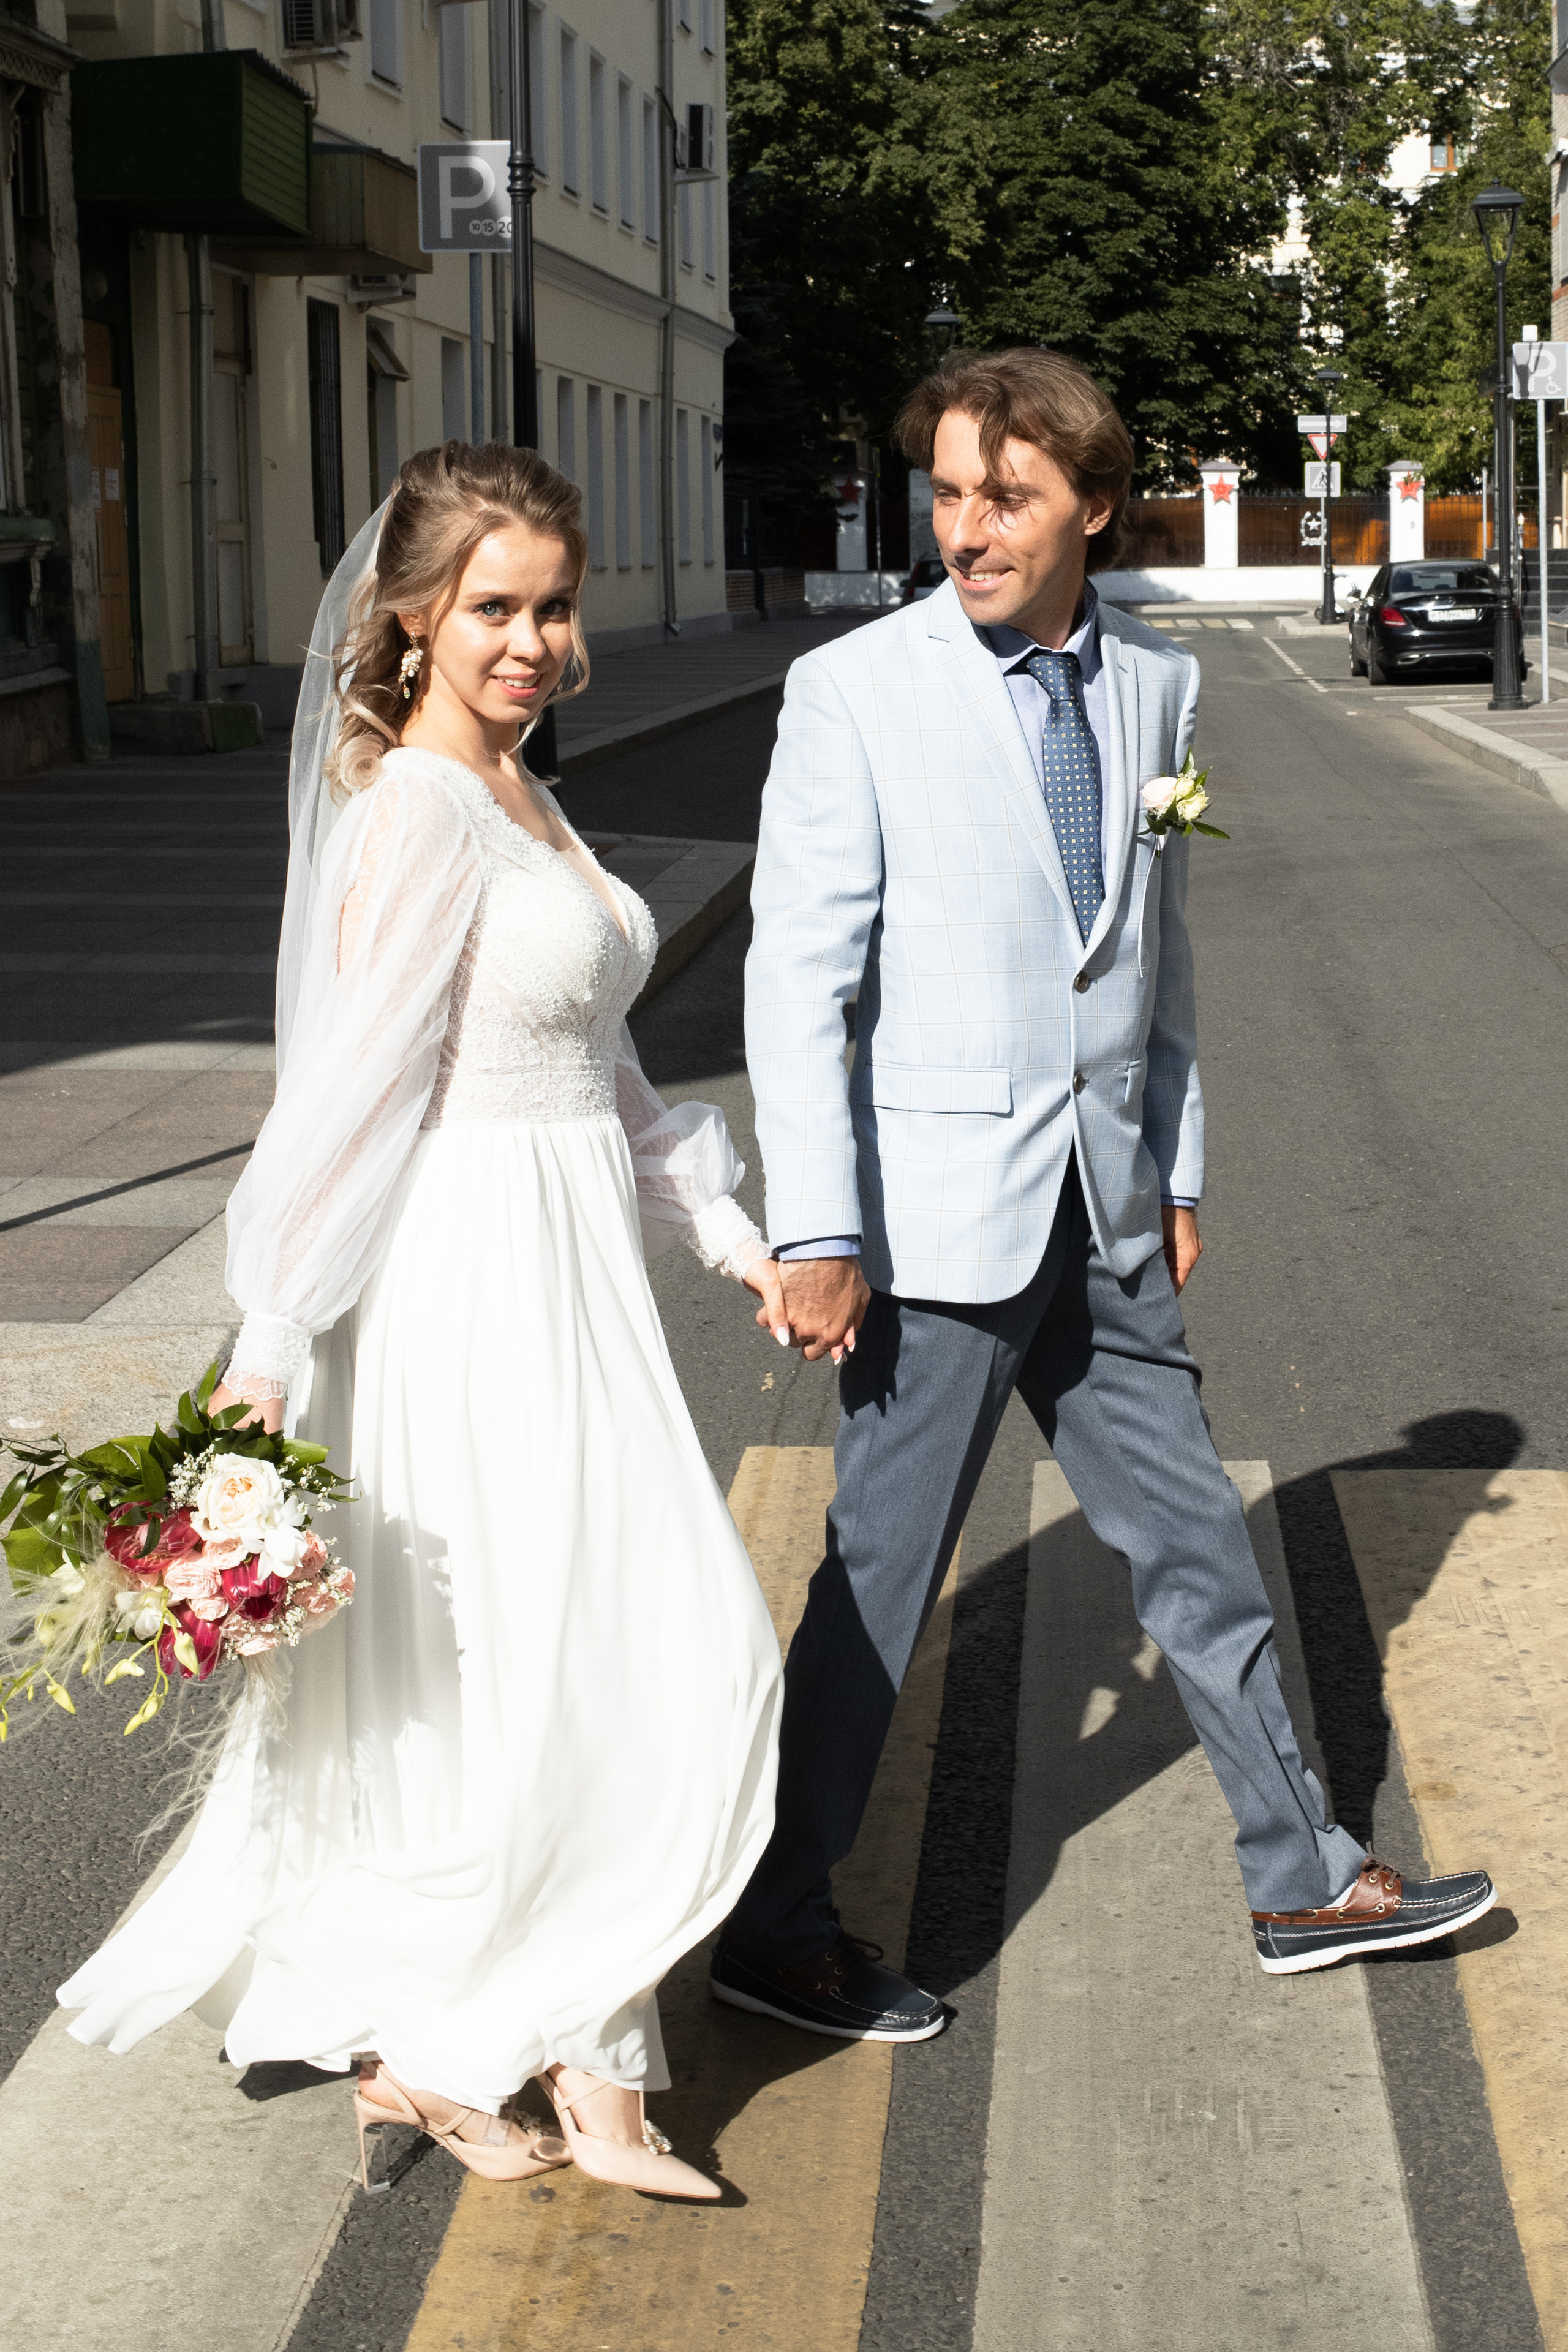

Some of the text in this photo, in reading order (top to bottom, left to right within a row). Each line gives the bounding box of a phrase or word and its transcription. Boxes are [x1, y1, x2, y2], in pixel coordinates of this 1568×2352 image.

[439, 156, 495, 239] P
[484, 222, 494, 232] 15
[1528, 349, 1556, 392] P
